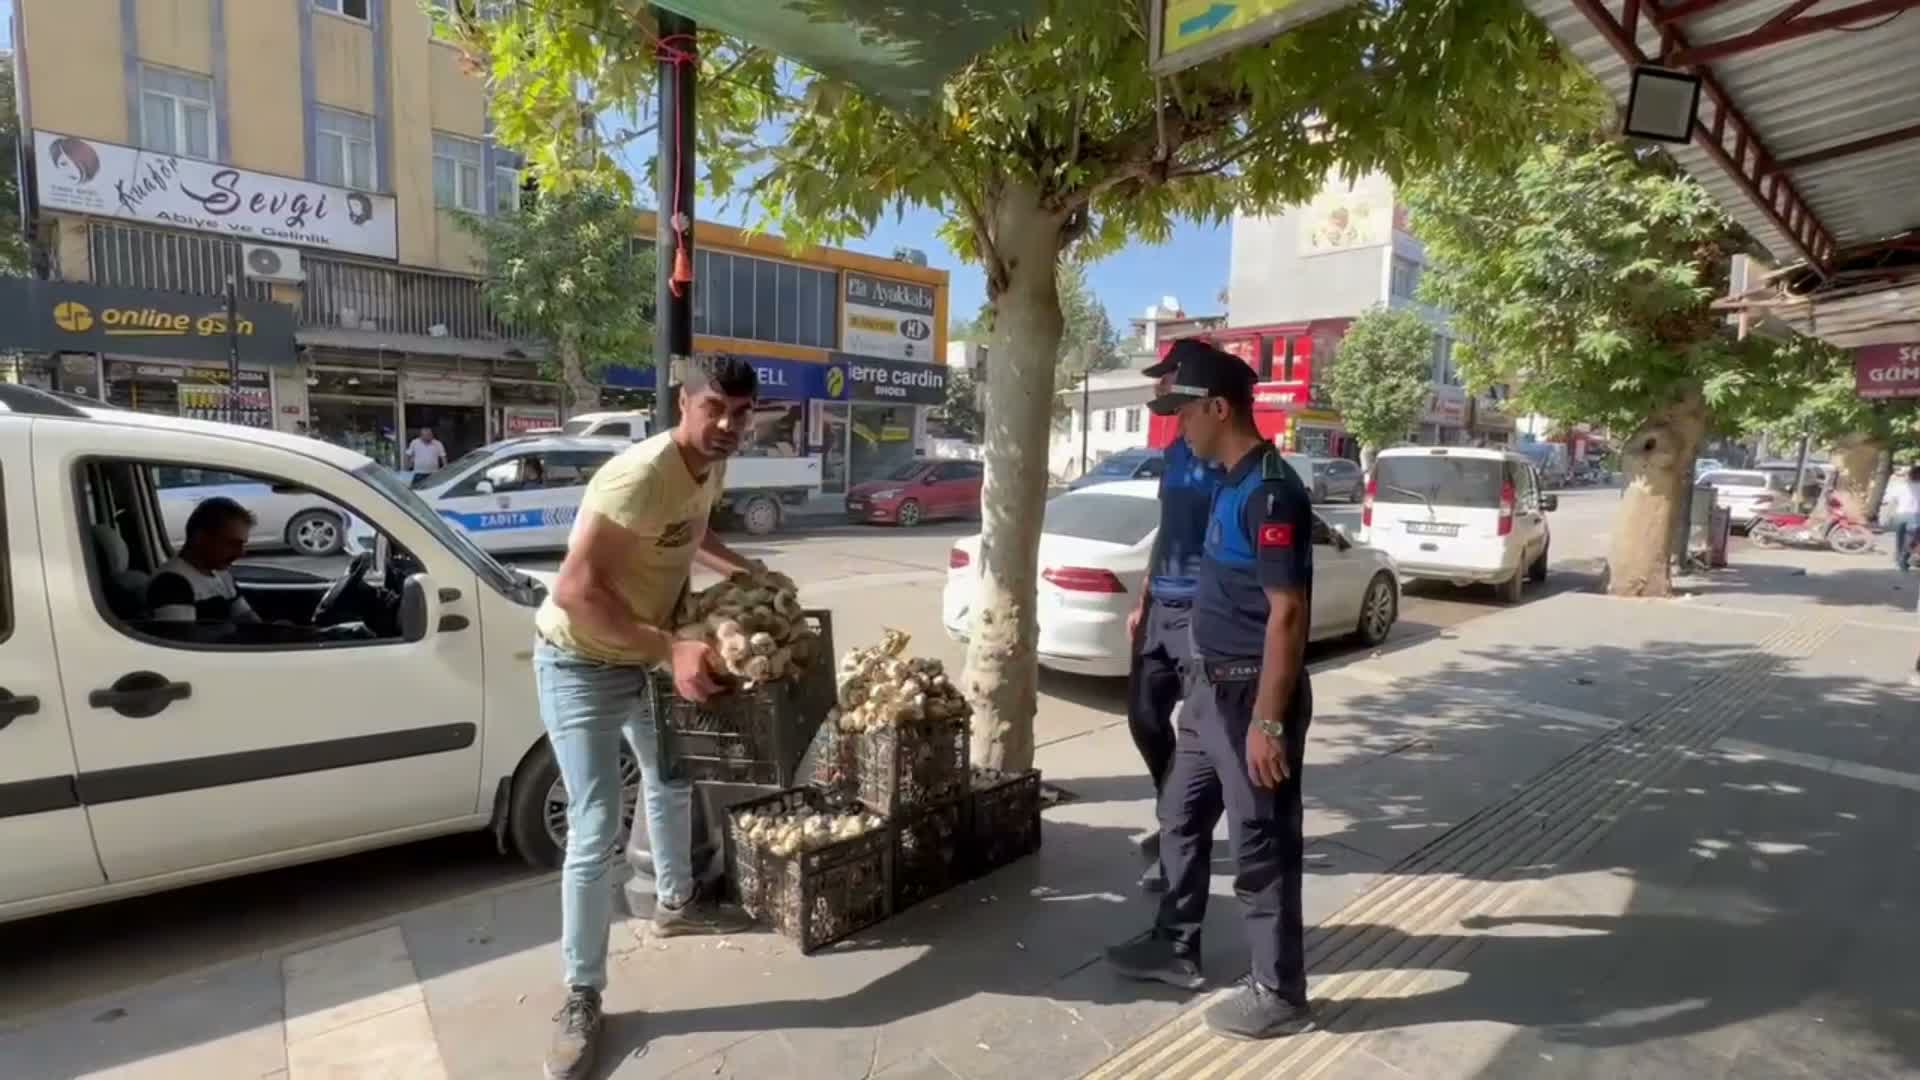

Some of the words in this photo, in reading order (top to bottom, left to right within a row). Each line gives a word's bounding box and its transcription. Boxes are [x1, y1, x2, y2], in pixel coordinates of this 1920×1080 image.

[180, 169, 329, 228] Sevgi
[156, 211, 219, 228] Abiye
[228, 223, 253, 232] ve
[261, 226, 330, 244] Gelinlik
[101, 308, 191, 331] online
[757, 366, 788, 387] ELL
[848, 361, 888, 384] ierre
[892, 368, 944, 388] cardin
[875, 385, 907, 398] SHOES
